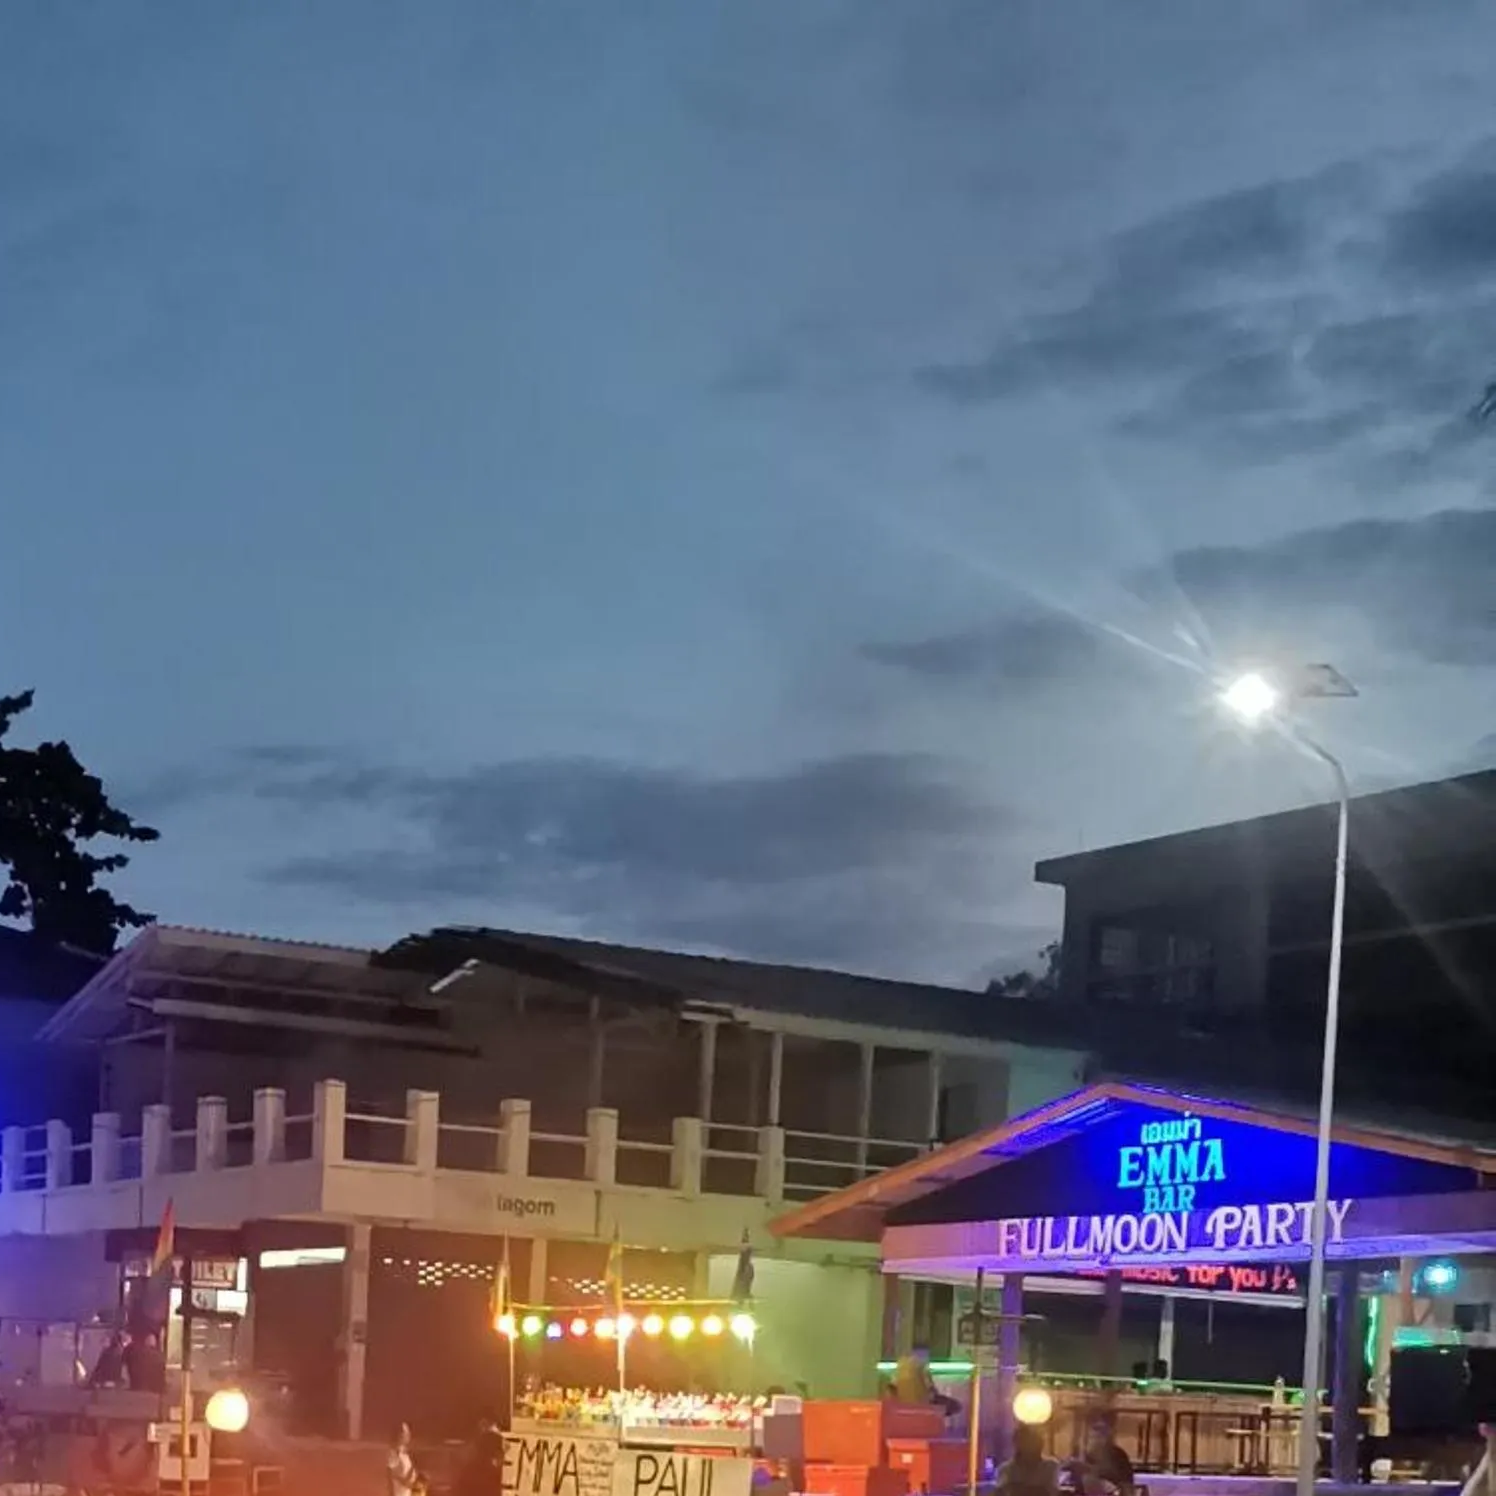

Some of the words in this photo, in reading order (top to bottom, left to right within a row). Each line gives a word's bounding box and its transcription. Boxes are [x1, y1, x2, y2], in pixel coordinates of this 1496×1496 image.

[1117, 1138, 1226, 1188] EMMA
[1143, 1185, 1196, 1213] BAR
[998, 1211, 1189, 1260] FULLMOON
[1205, 1199, 1353, 1250] PARTY
